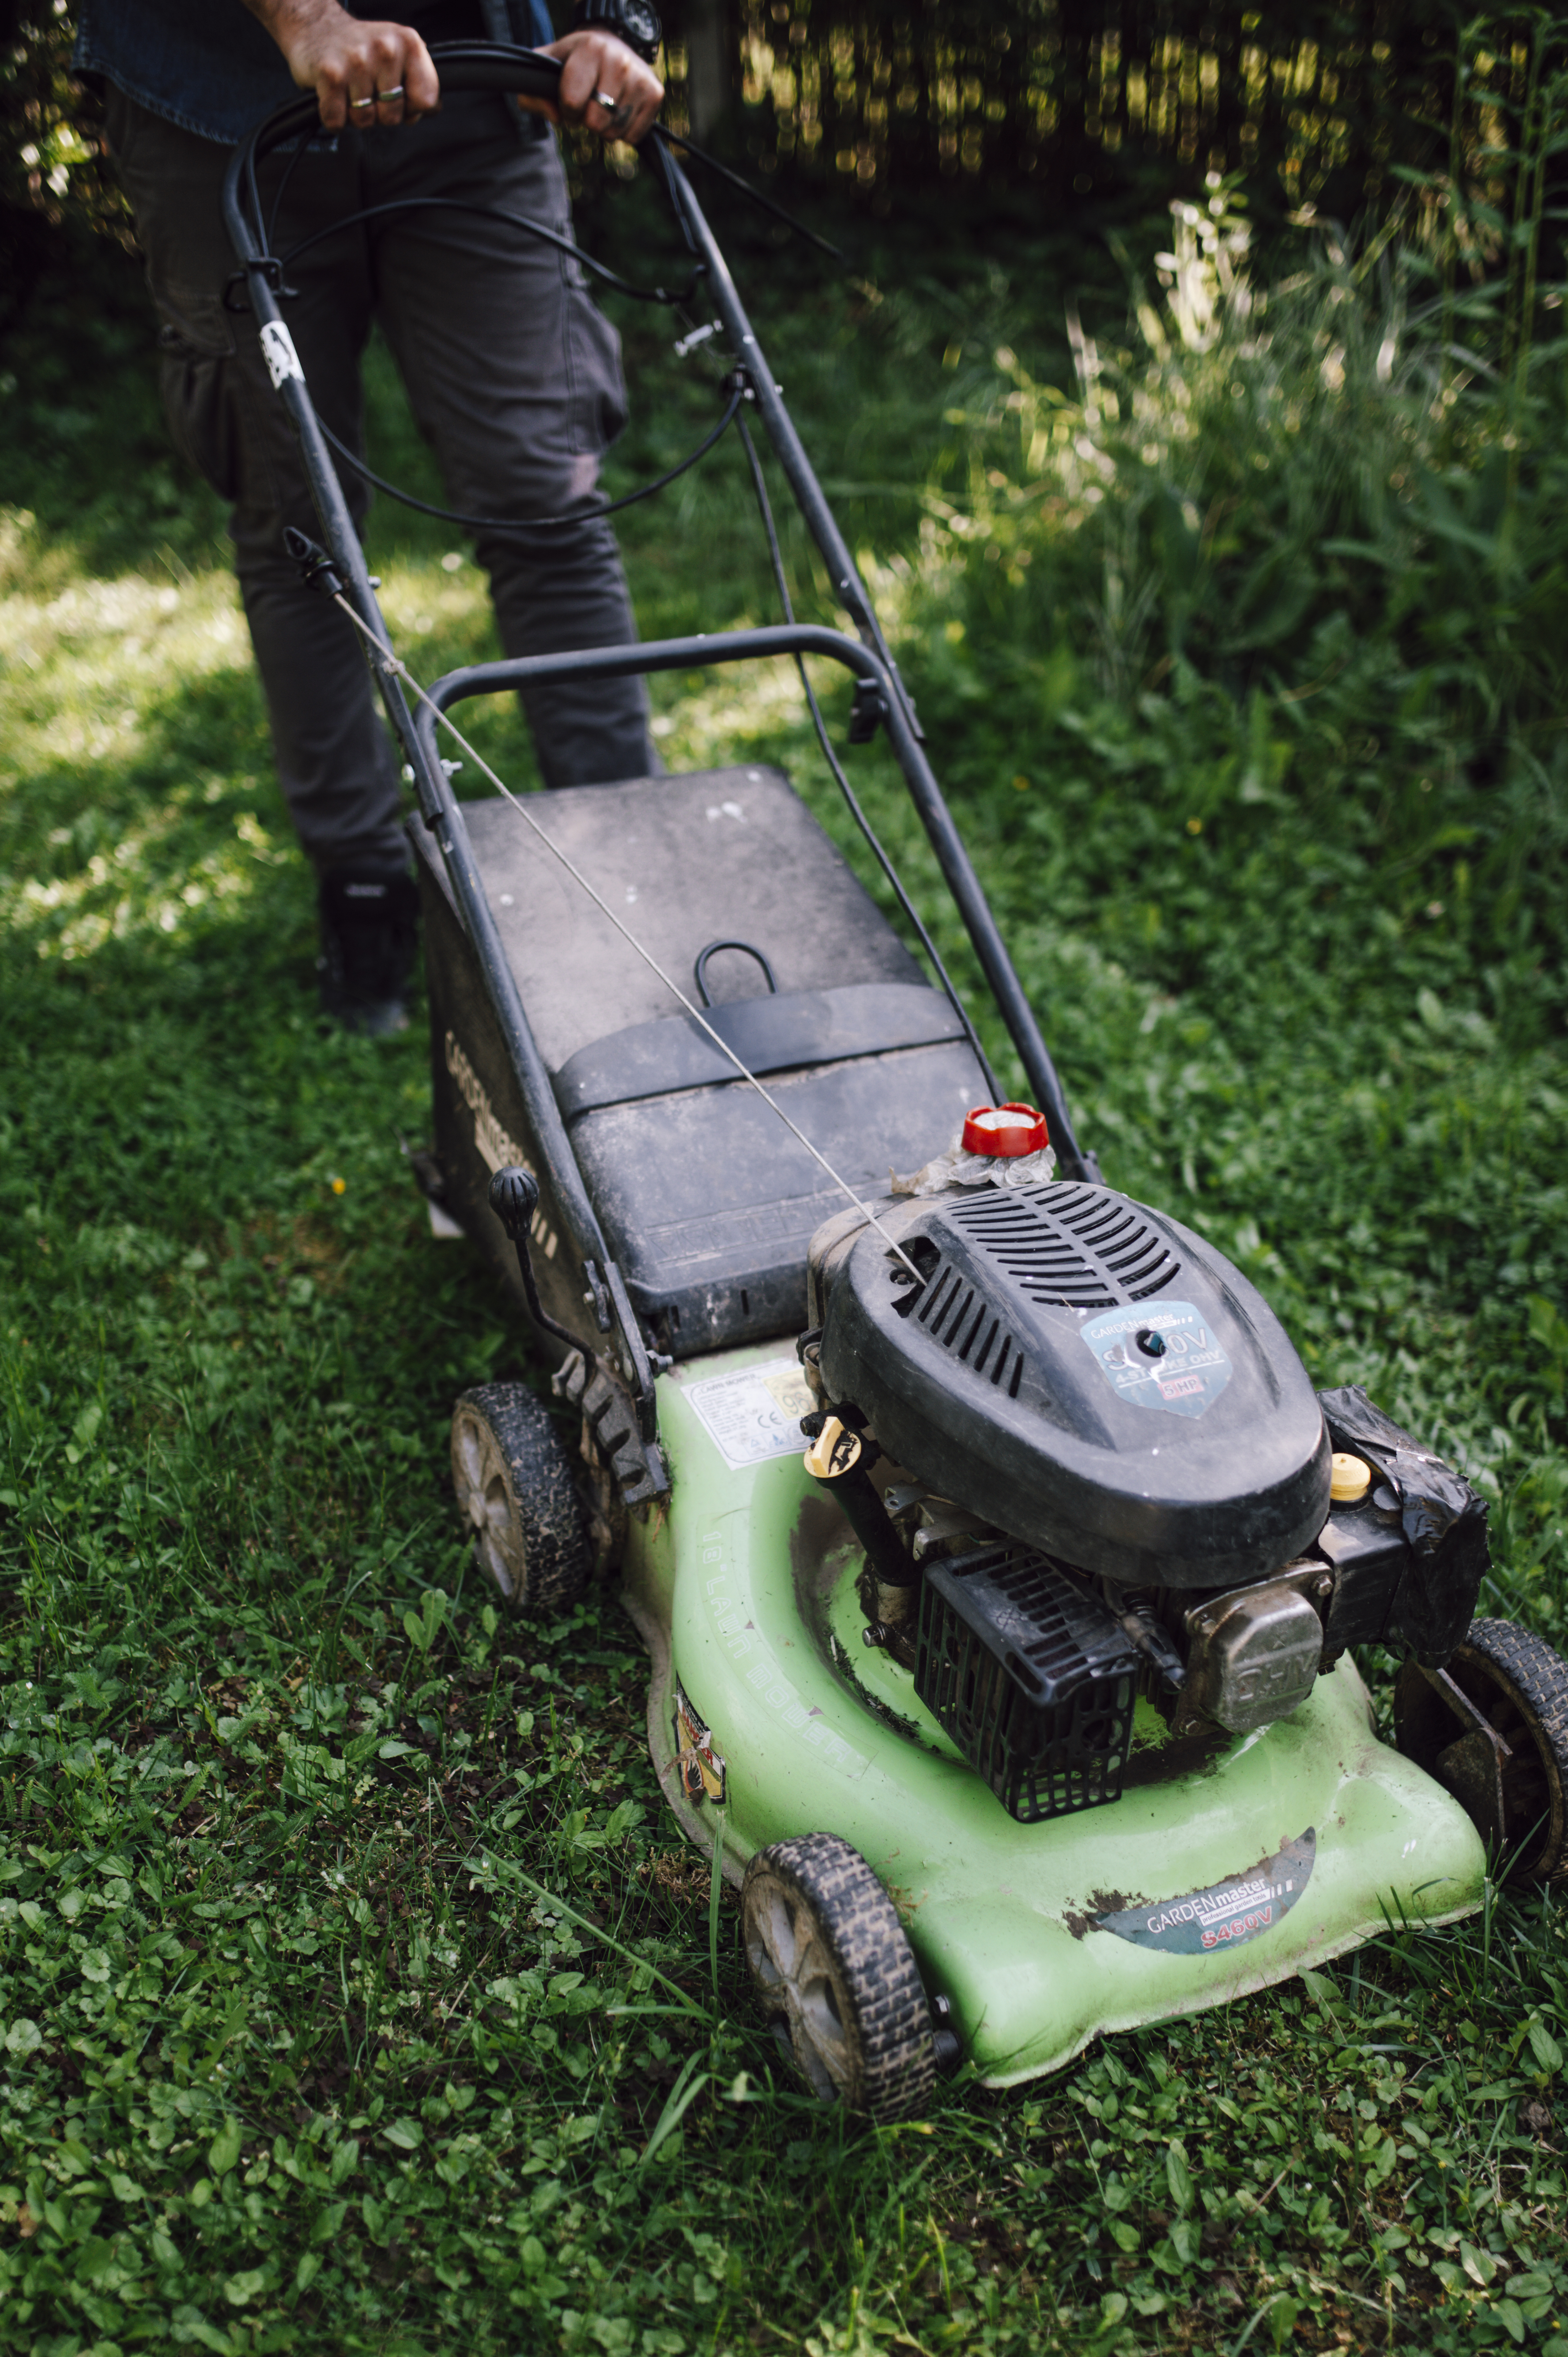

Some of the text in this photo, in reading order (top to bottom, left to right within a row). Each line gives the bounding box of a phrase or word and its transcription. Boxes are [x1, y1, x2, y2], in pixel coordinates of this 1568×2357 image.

[1091, 1313, 1173, 1339] GARDENmaster
[1103, 1327, 1207, 1371] S0V
[1116, 1350, 1220, 1383] 4-STKE OHV
[701, 1374, 755, 1394] LAWN MOWER
[1162, 1378, 1198, 1397] 5 HP
[783, 1392, 811, 1414] 96
[706, 1575, 751, 1659] LAWN
[746, 1663, 852, 1763] MOWER
[1147, 1878, 1266, 1934] GARDENmaster
[1202, 1893, 1266, 1924] professional garden tools
[1201, 1905, 1272, 1949] S460V
